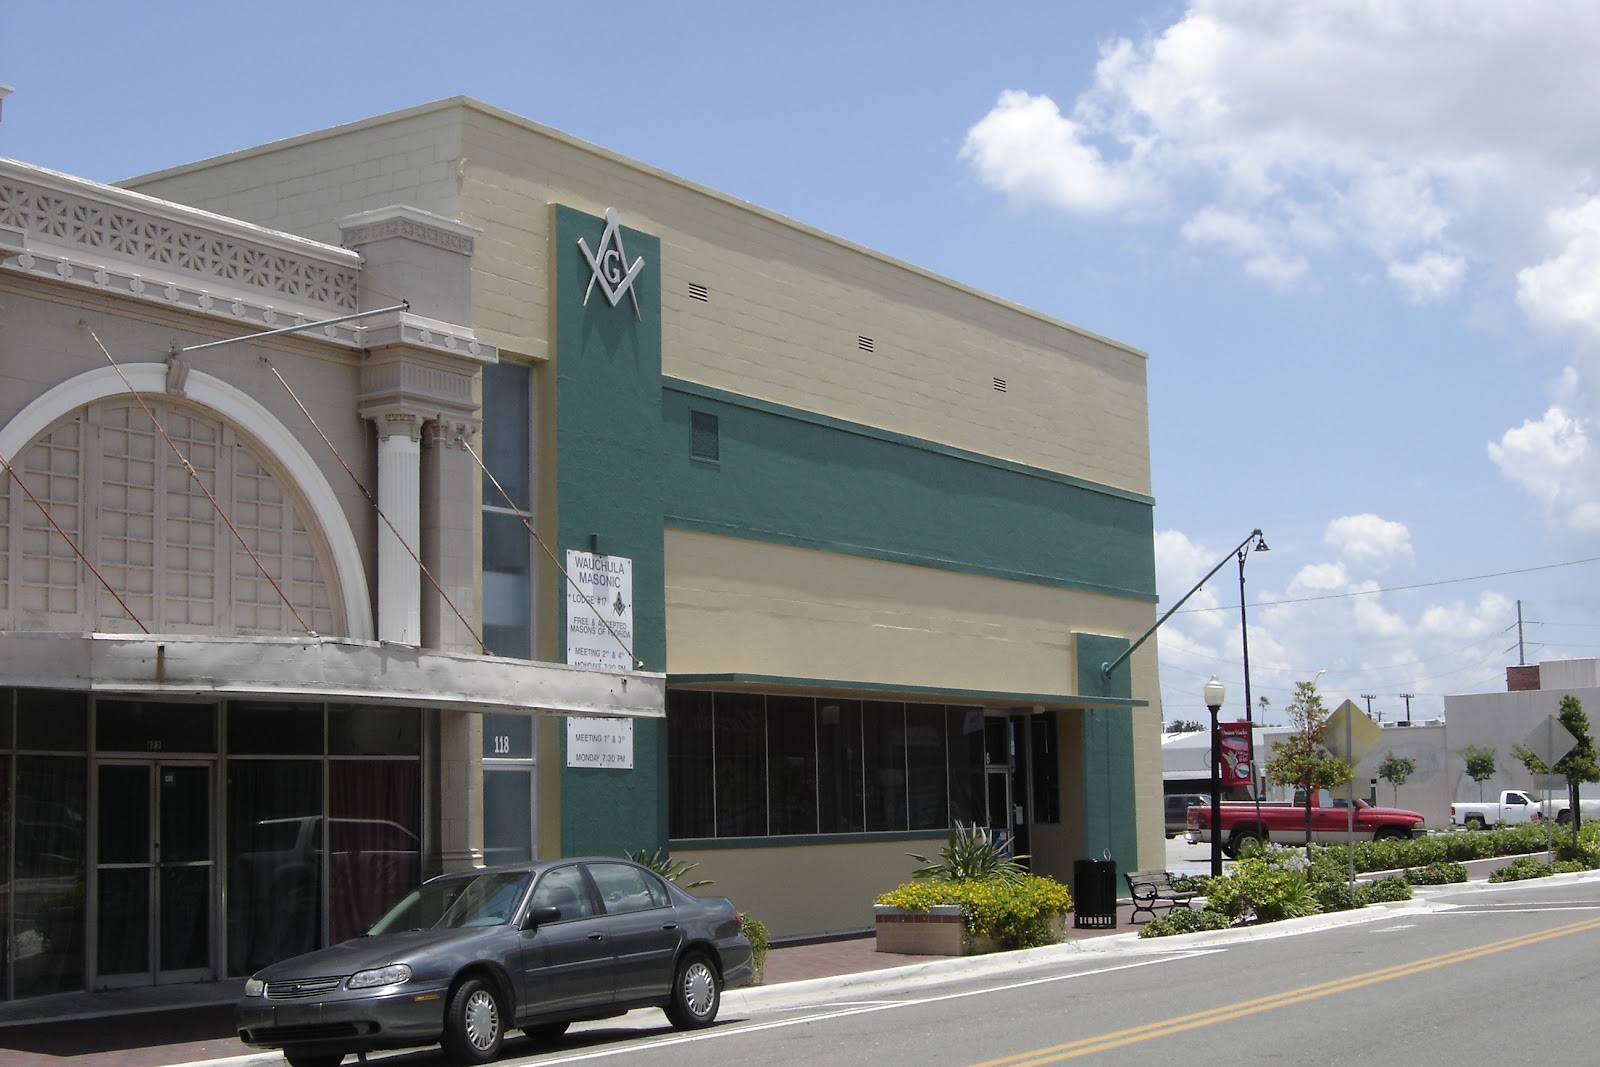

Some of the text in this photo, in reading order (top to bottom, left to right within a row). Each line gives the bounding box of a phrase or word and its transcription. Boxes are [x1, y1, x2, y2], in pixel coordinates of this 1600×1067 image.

[604, 250, 620, 284] G
[575, 557, 624, 574] WAUCHULA
[580, 572, 620, 588] MASONIC
[572, 594, 594, 604] LODGE
[574, 616, 589, 626] FREE
[598, 619, 627, 630] ACCEPTED
[570, 625, 596, 635] MASONS
[608, 629, 631, 638] FLORIDA
[575, 648, 600, 657] MEETING
[494, 736, 509, 753] 118
[576, 734, 602, 742] MEETING
